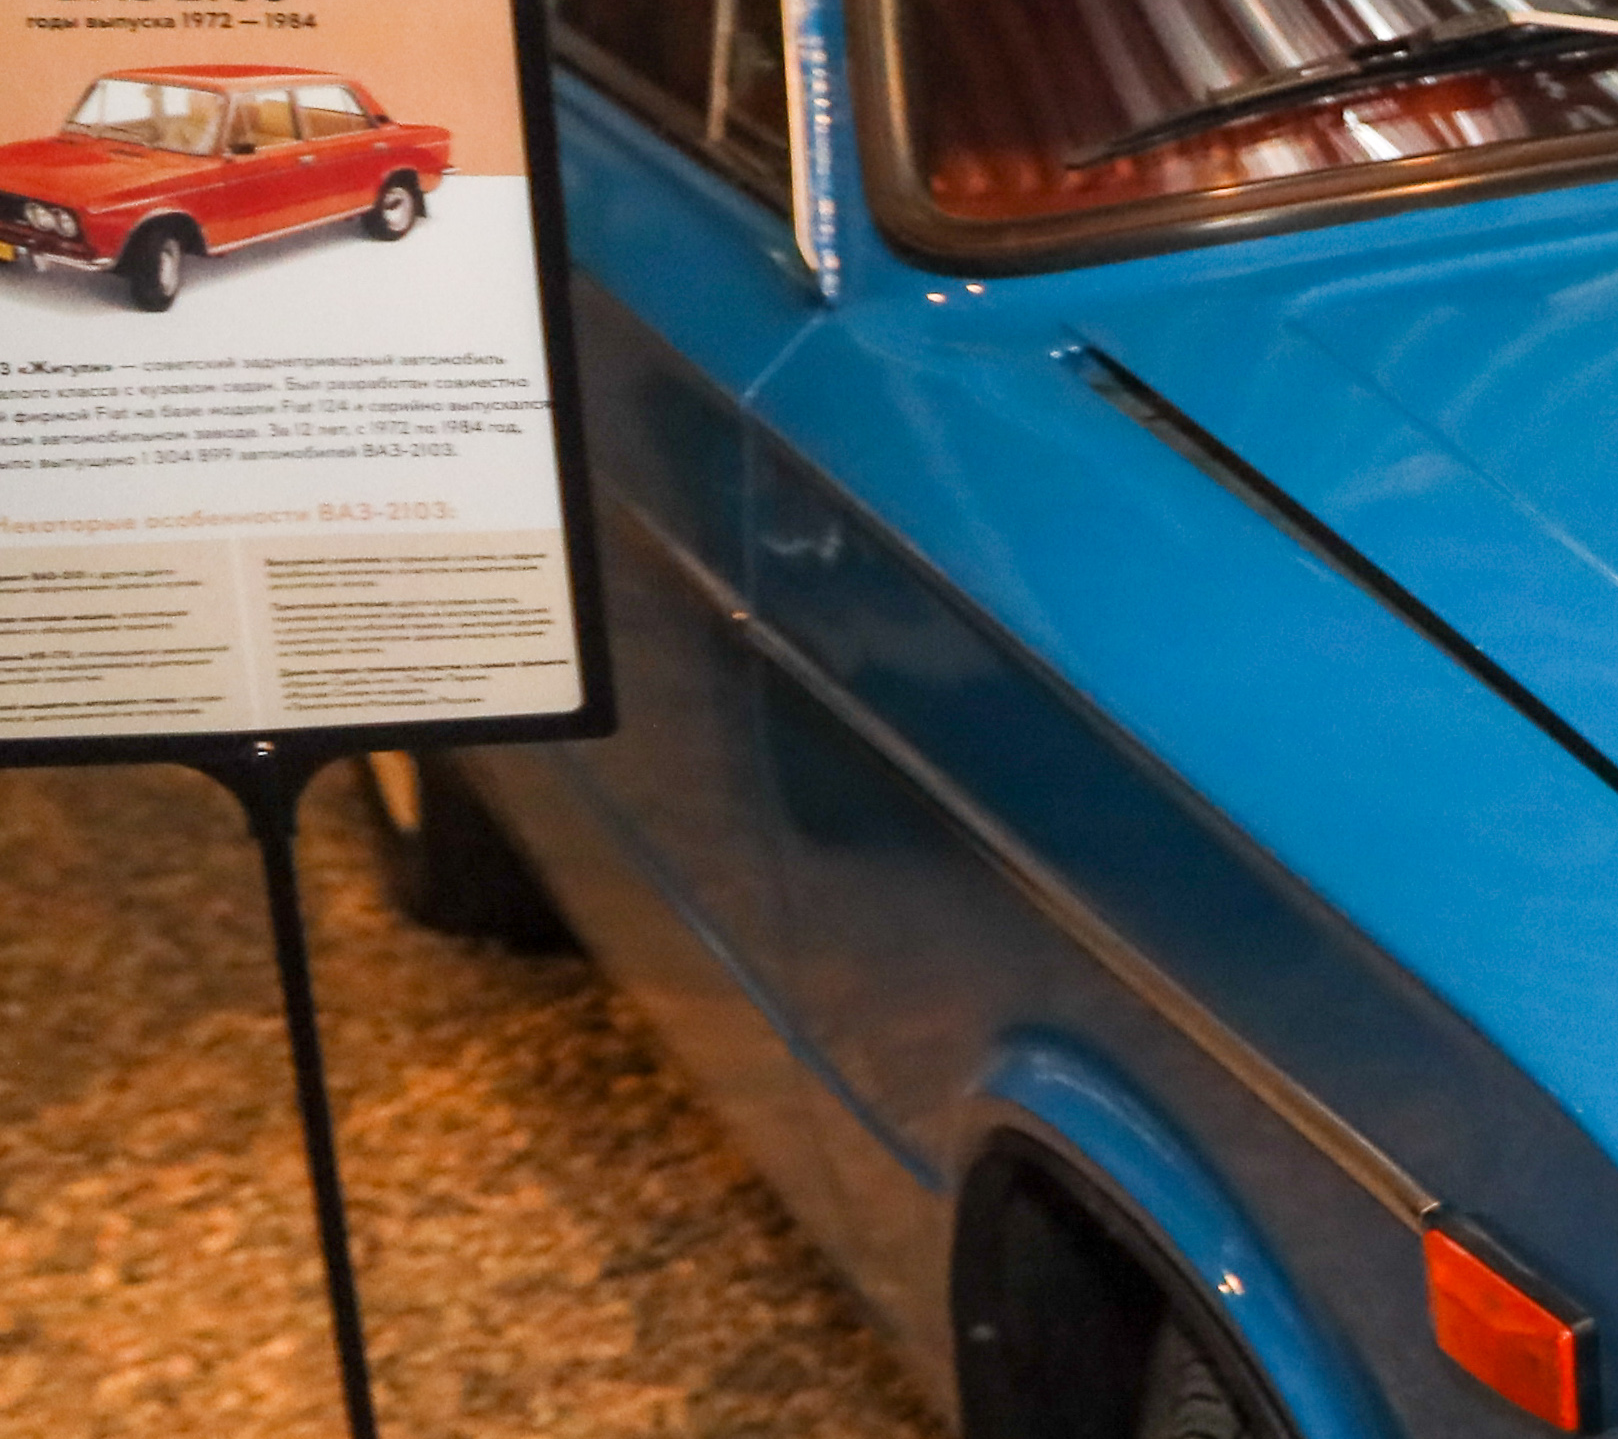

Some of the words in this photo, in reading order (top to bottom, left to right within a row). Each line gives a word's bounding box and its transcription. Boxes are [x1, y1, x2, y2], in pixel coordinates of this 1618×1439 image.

[25, 16, 78, 30] годы
[86, 16, 176, 33] выпуска
[182, 12, 233, 28] 1972
[265, 12, 317, 29] 1984
